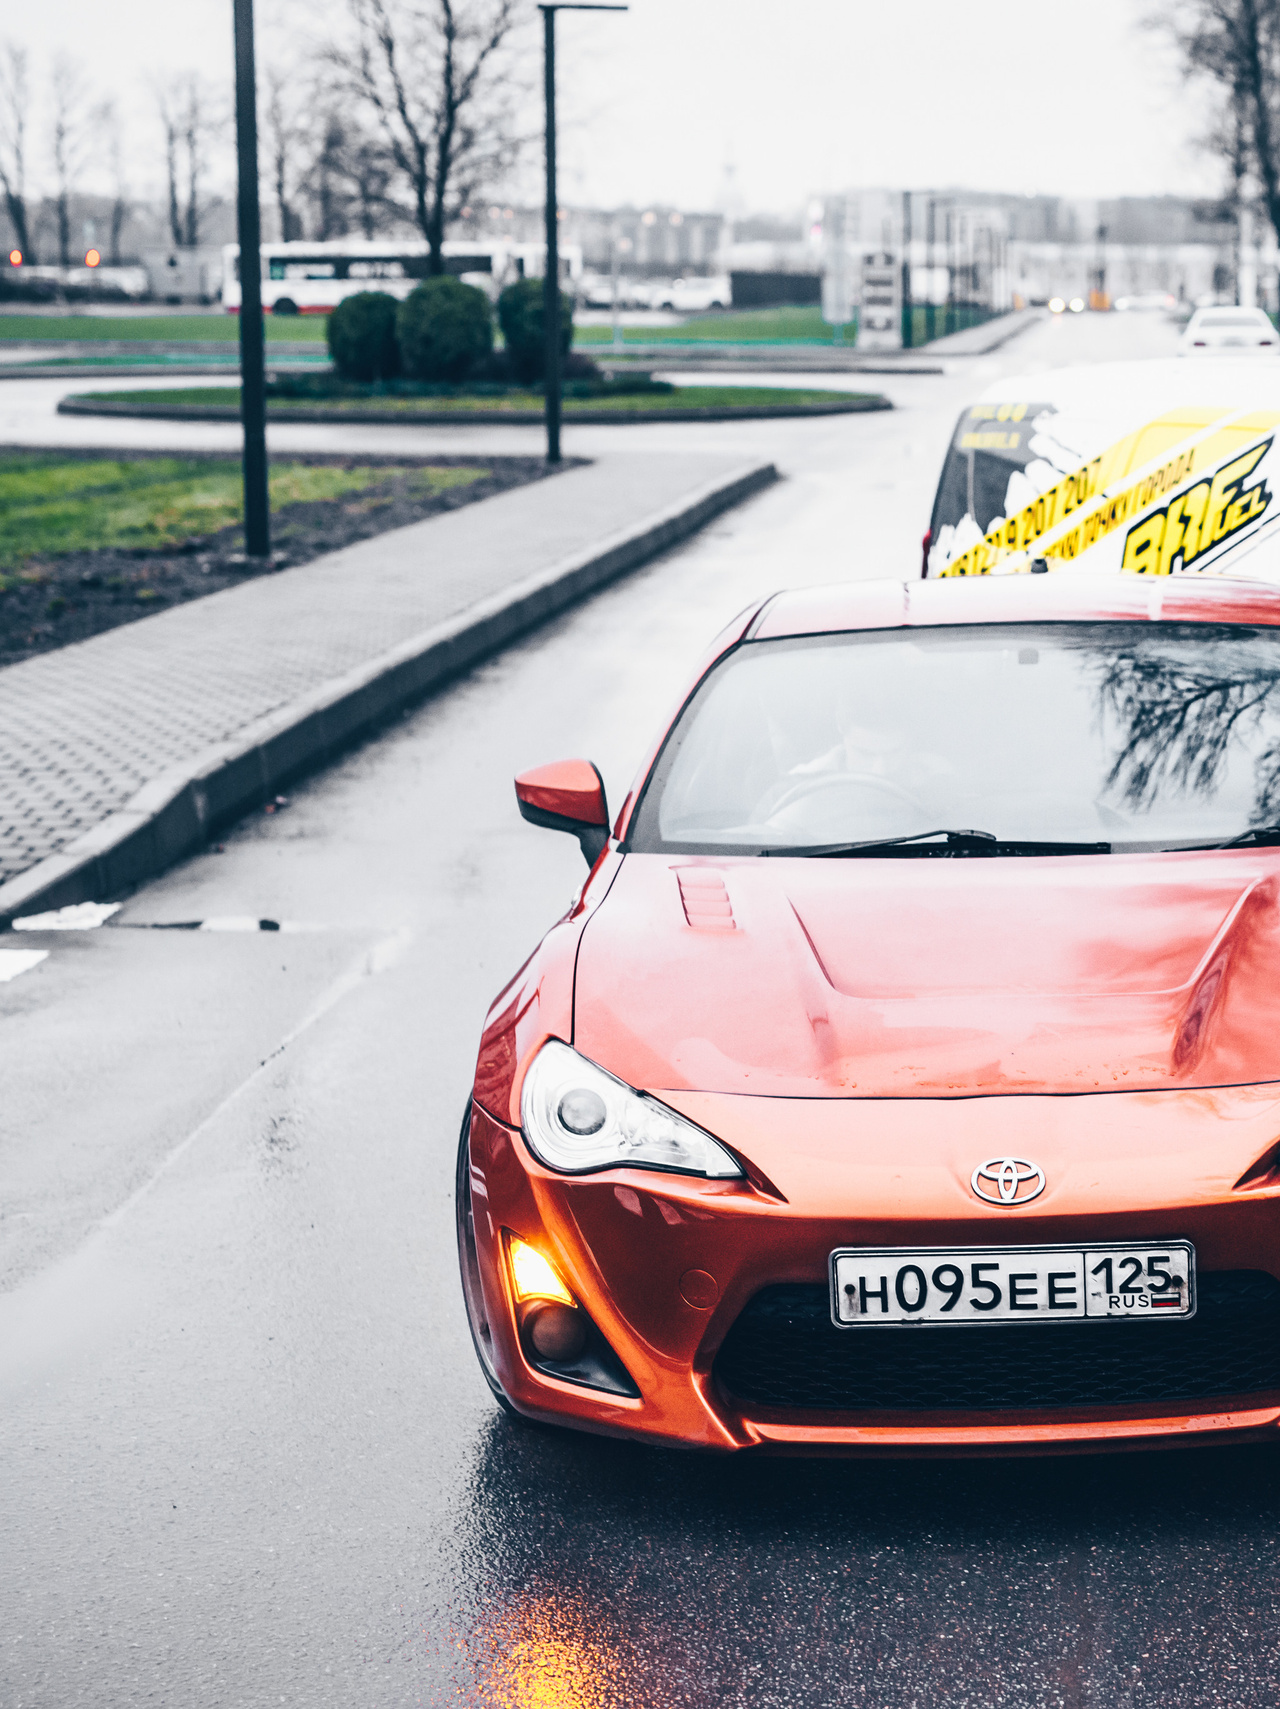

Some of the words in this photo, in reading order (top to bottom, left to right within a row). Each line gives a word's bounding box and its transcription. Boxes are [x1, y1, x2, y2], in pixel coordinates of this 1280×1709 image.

[858, 1262, 1079, 1313] H095EE
[1090, 1255, 1174, 1295] 125
[1108, 1294, 1150, 1310] RUS
